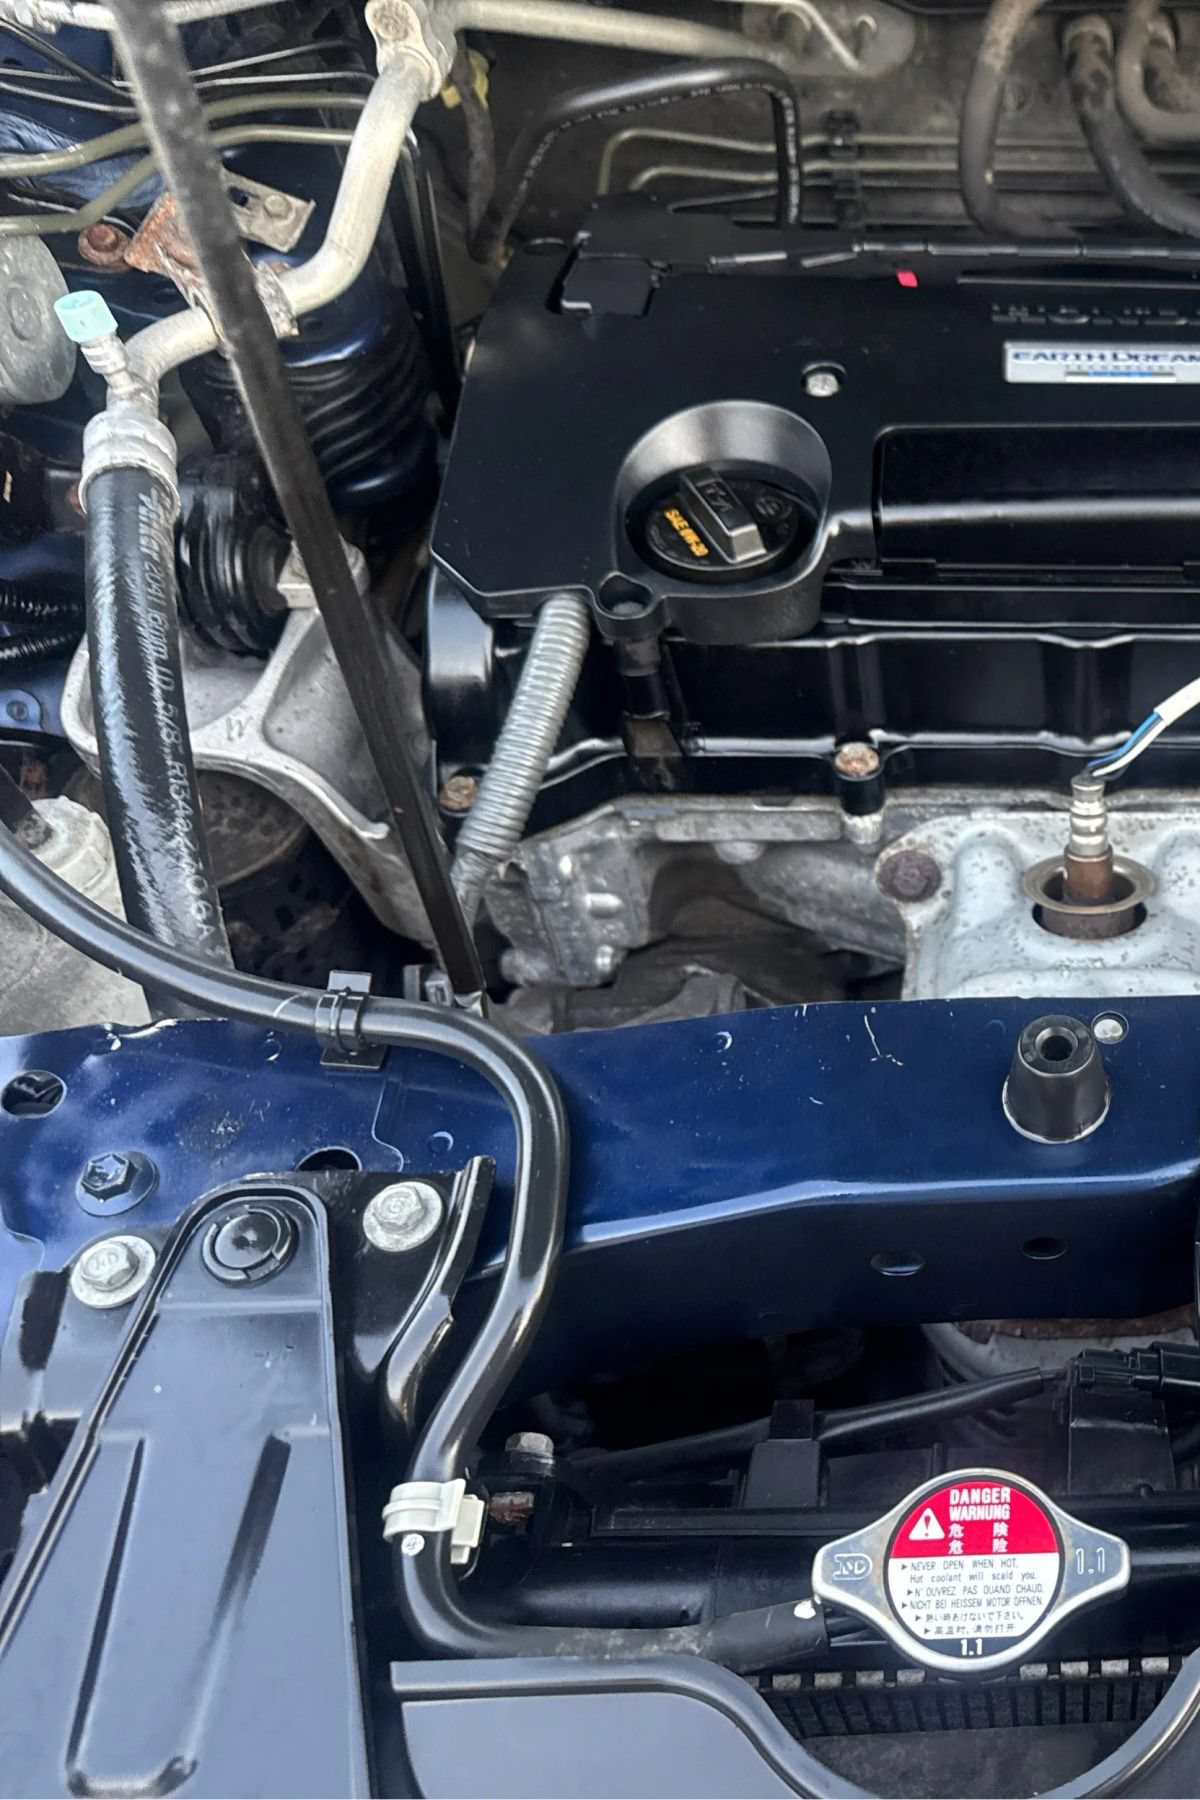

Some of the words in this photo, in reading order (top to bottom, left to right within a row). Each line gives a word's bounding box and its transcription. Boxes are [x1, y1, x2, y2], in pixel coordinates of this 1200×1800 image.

[1012, 352, 1107, 362] EARTH
[145, 560, 167, 606] 2041
[949, 1487, 1011, 1505] DANGER
[949, 1504, 1011, 1521] WARNUNG
[911, 1561, 936, 1571] NEVER
[943, 1560, 964, 1570] OPEN
[972, 1559, 994, 1569] WHEN
[1001, 1558, 1019, 1568] HOT.
[1076, 1547, 1106, 1576] 1.1
[910, 1574, 923, 1584] Hot
[931, 1573, 962, 1583] coolant
[969, 1572, 984, 1581] will
[992, 1571, 1014, 1581] scald
[1021, 1572, 1037, 1582] you.
[963, 1585, 978, 1595] PAS
[983, 1584, 1011, 1595] QUAND
[910, 1600, 931, 1610] NICHT
[935, 1600, 947, 1609] BEI
[951, 1598, 982, 1608] HEISSEM
[986, 1597, 1010, 1607] MOTOR
[960, 1638, 983, 1656] 1.1
